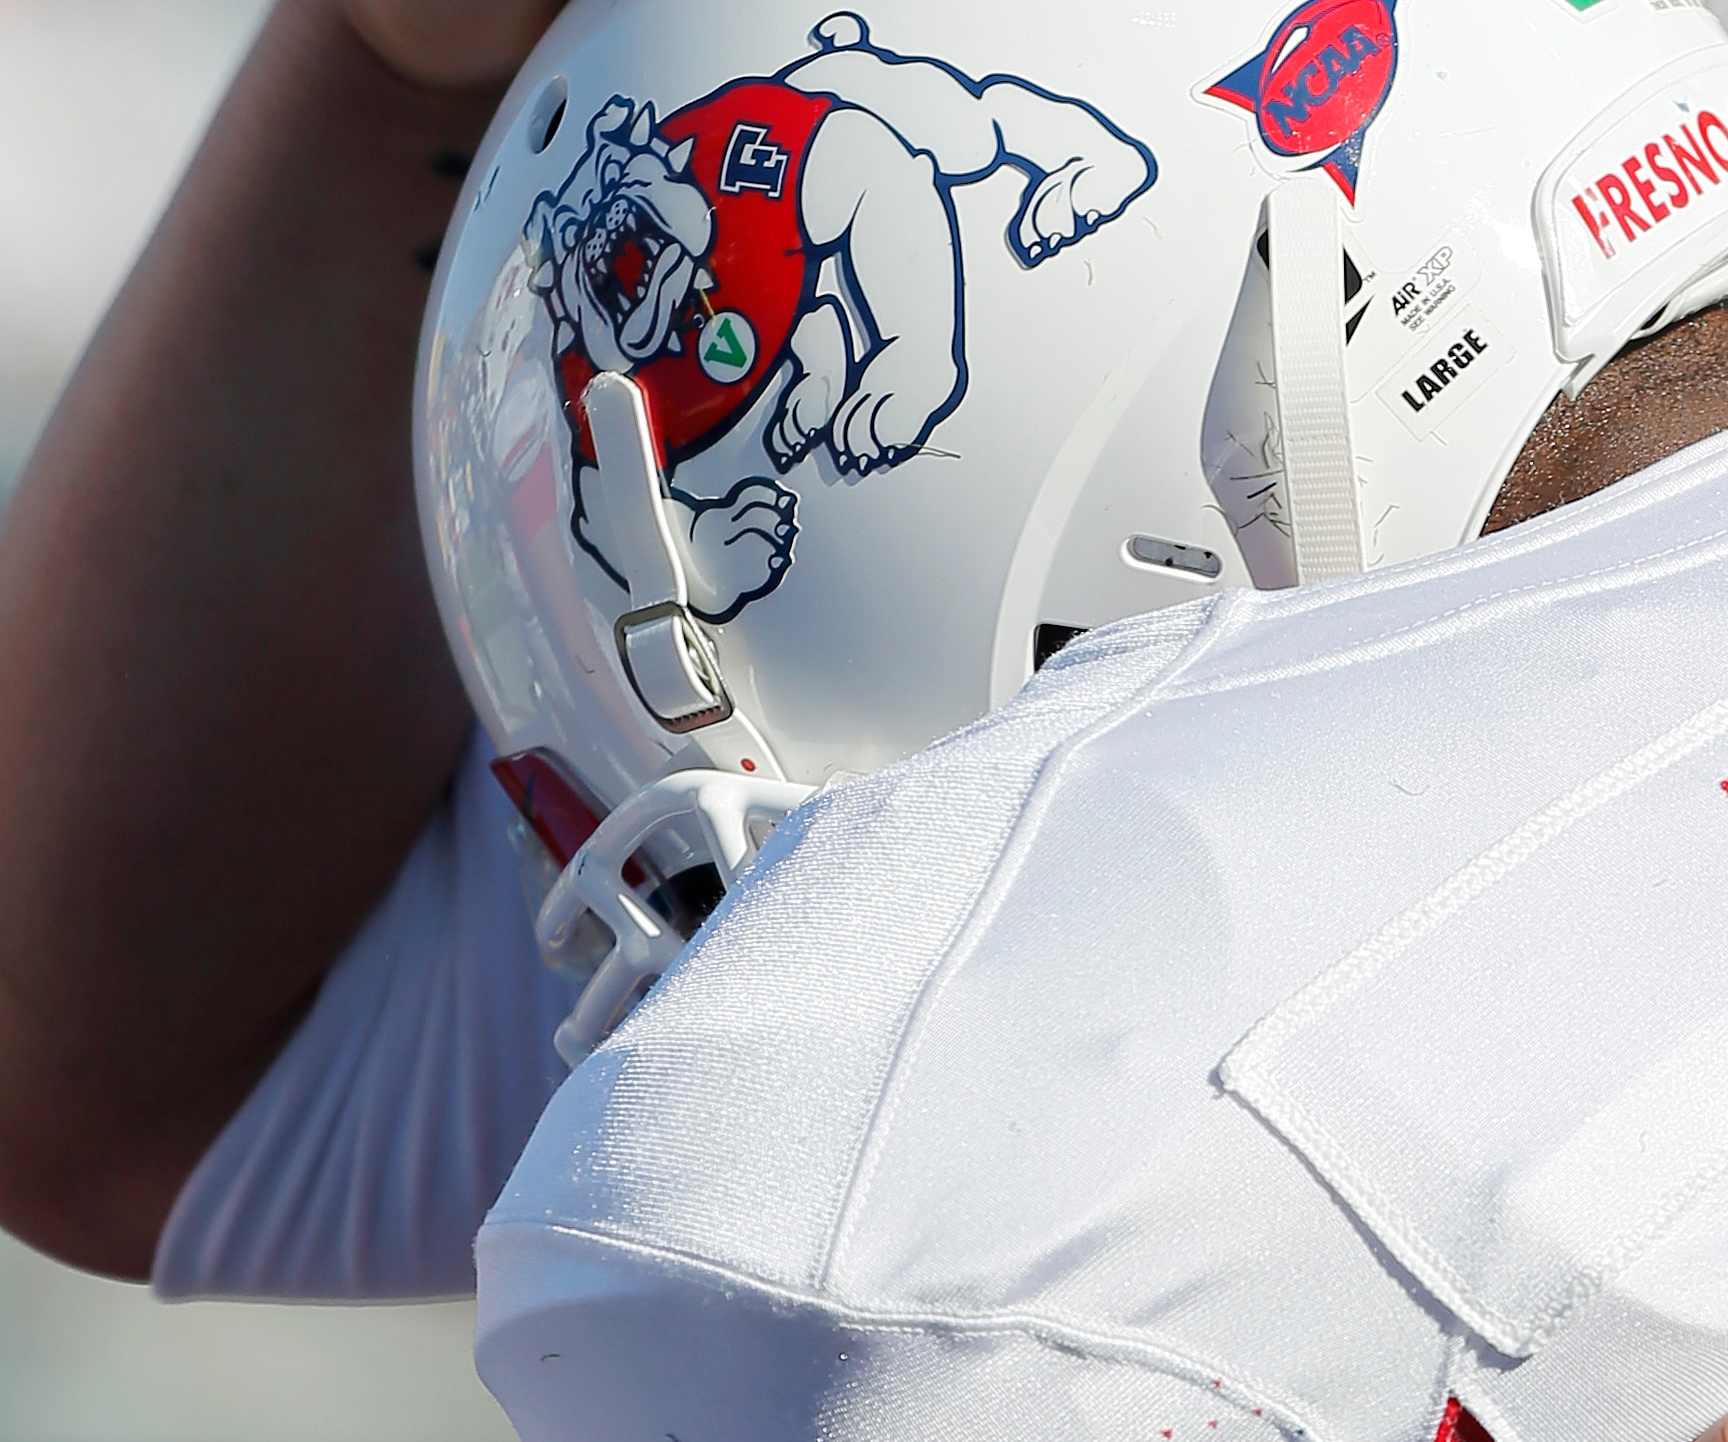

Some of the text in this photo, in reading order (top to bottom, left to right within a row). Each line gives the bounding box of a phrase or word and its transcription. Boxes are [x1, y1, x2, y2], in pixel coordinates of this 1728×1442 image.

[1417, 245, 1453, 287] XP
[1400, 304, 1422, 326] MADE
[1421, 296, 1430, 305] IN
[1409, 285, 1456, 331] SEE WARNING
[703, 317, 748, 369] V
[1401, 328, 1489, 413] LARGE
